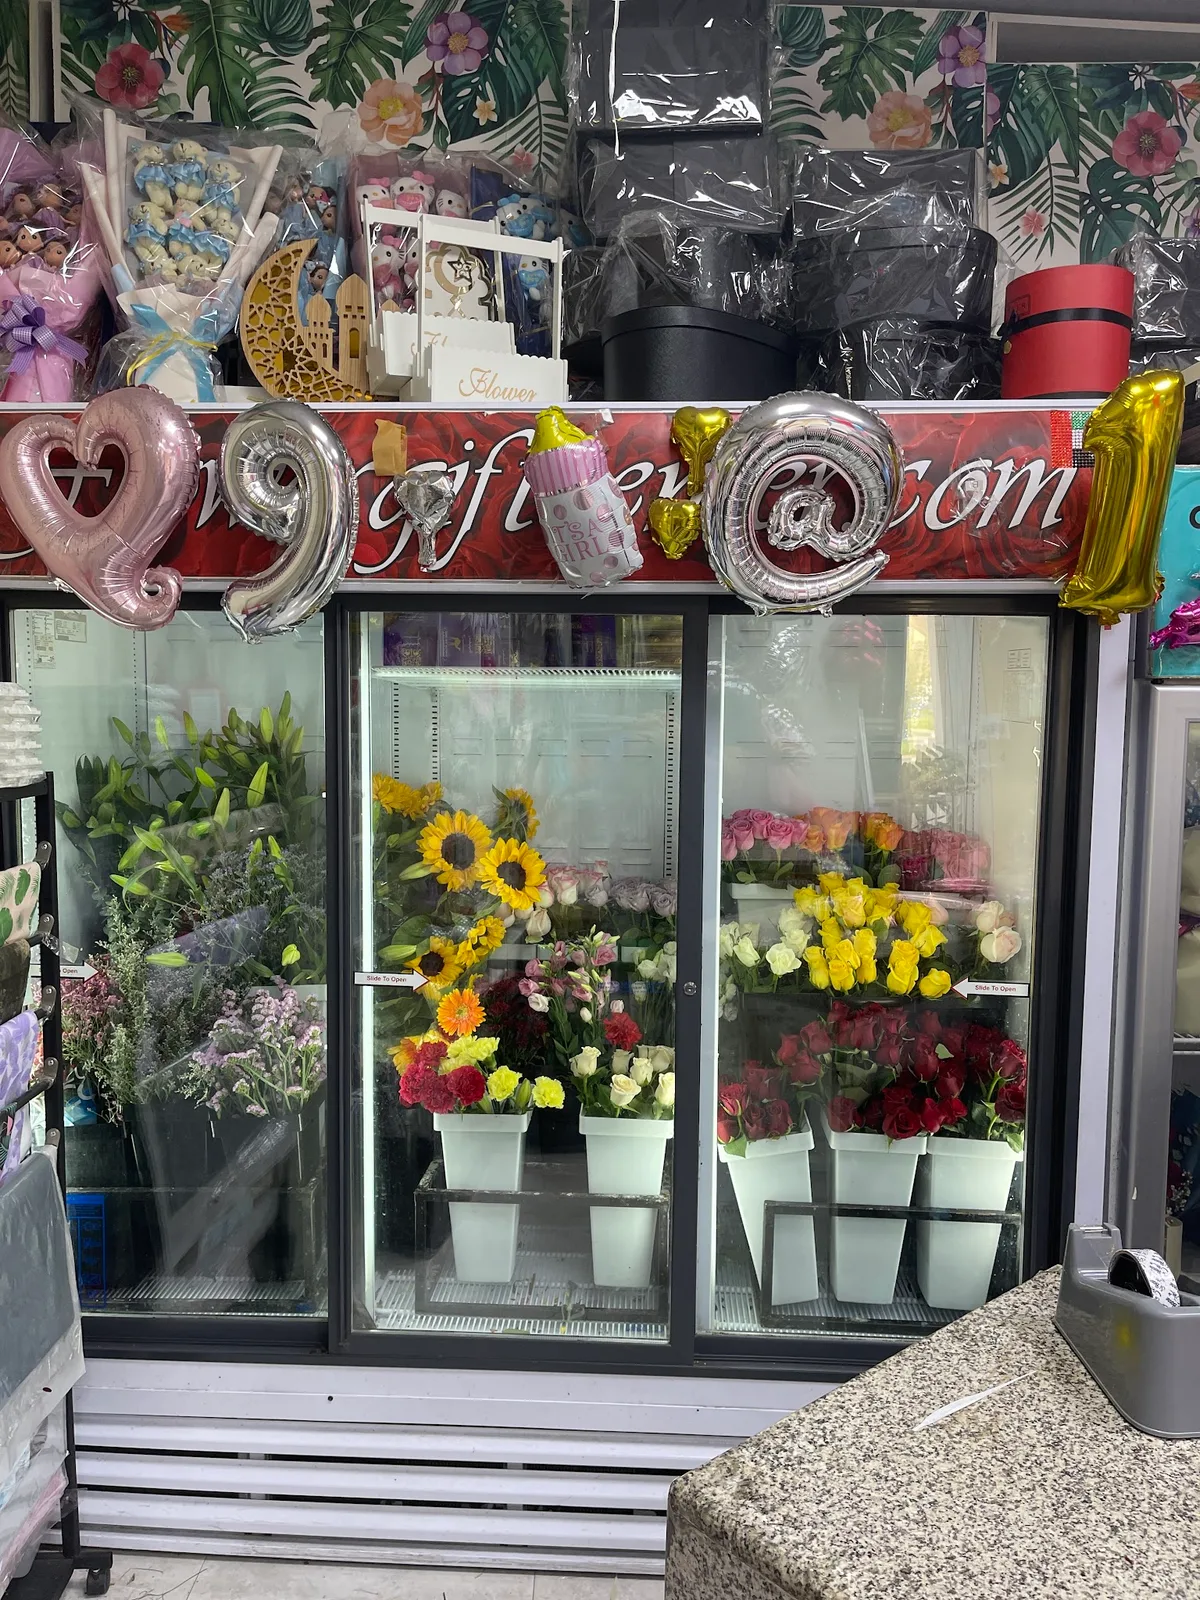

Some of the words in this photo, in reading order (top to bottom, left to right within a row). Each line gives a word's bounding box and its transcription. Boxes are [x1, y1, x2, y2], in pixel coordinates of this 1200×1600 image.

[459, 367, 537, 402] Flower
[552, 521, 584, 543] T'S
[588, 518, 603, 537] A
[555, 536, 610, 562] GIRL
